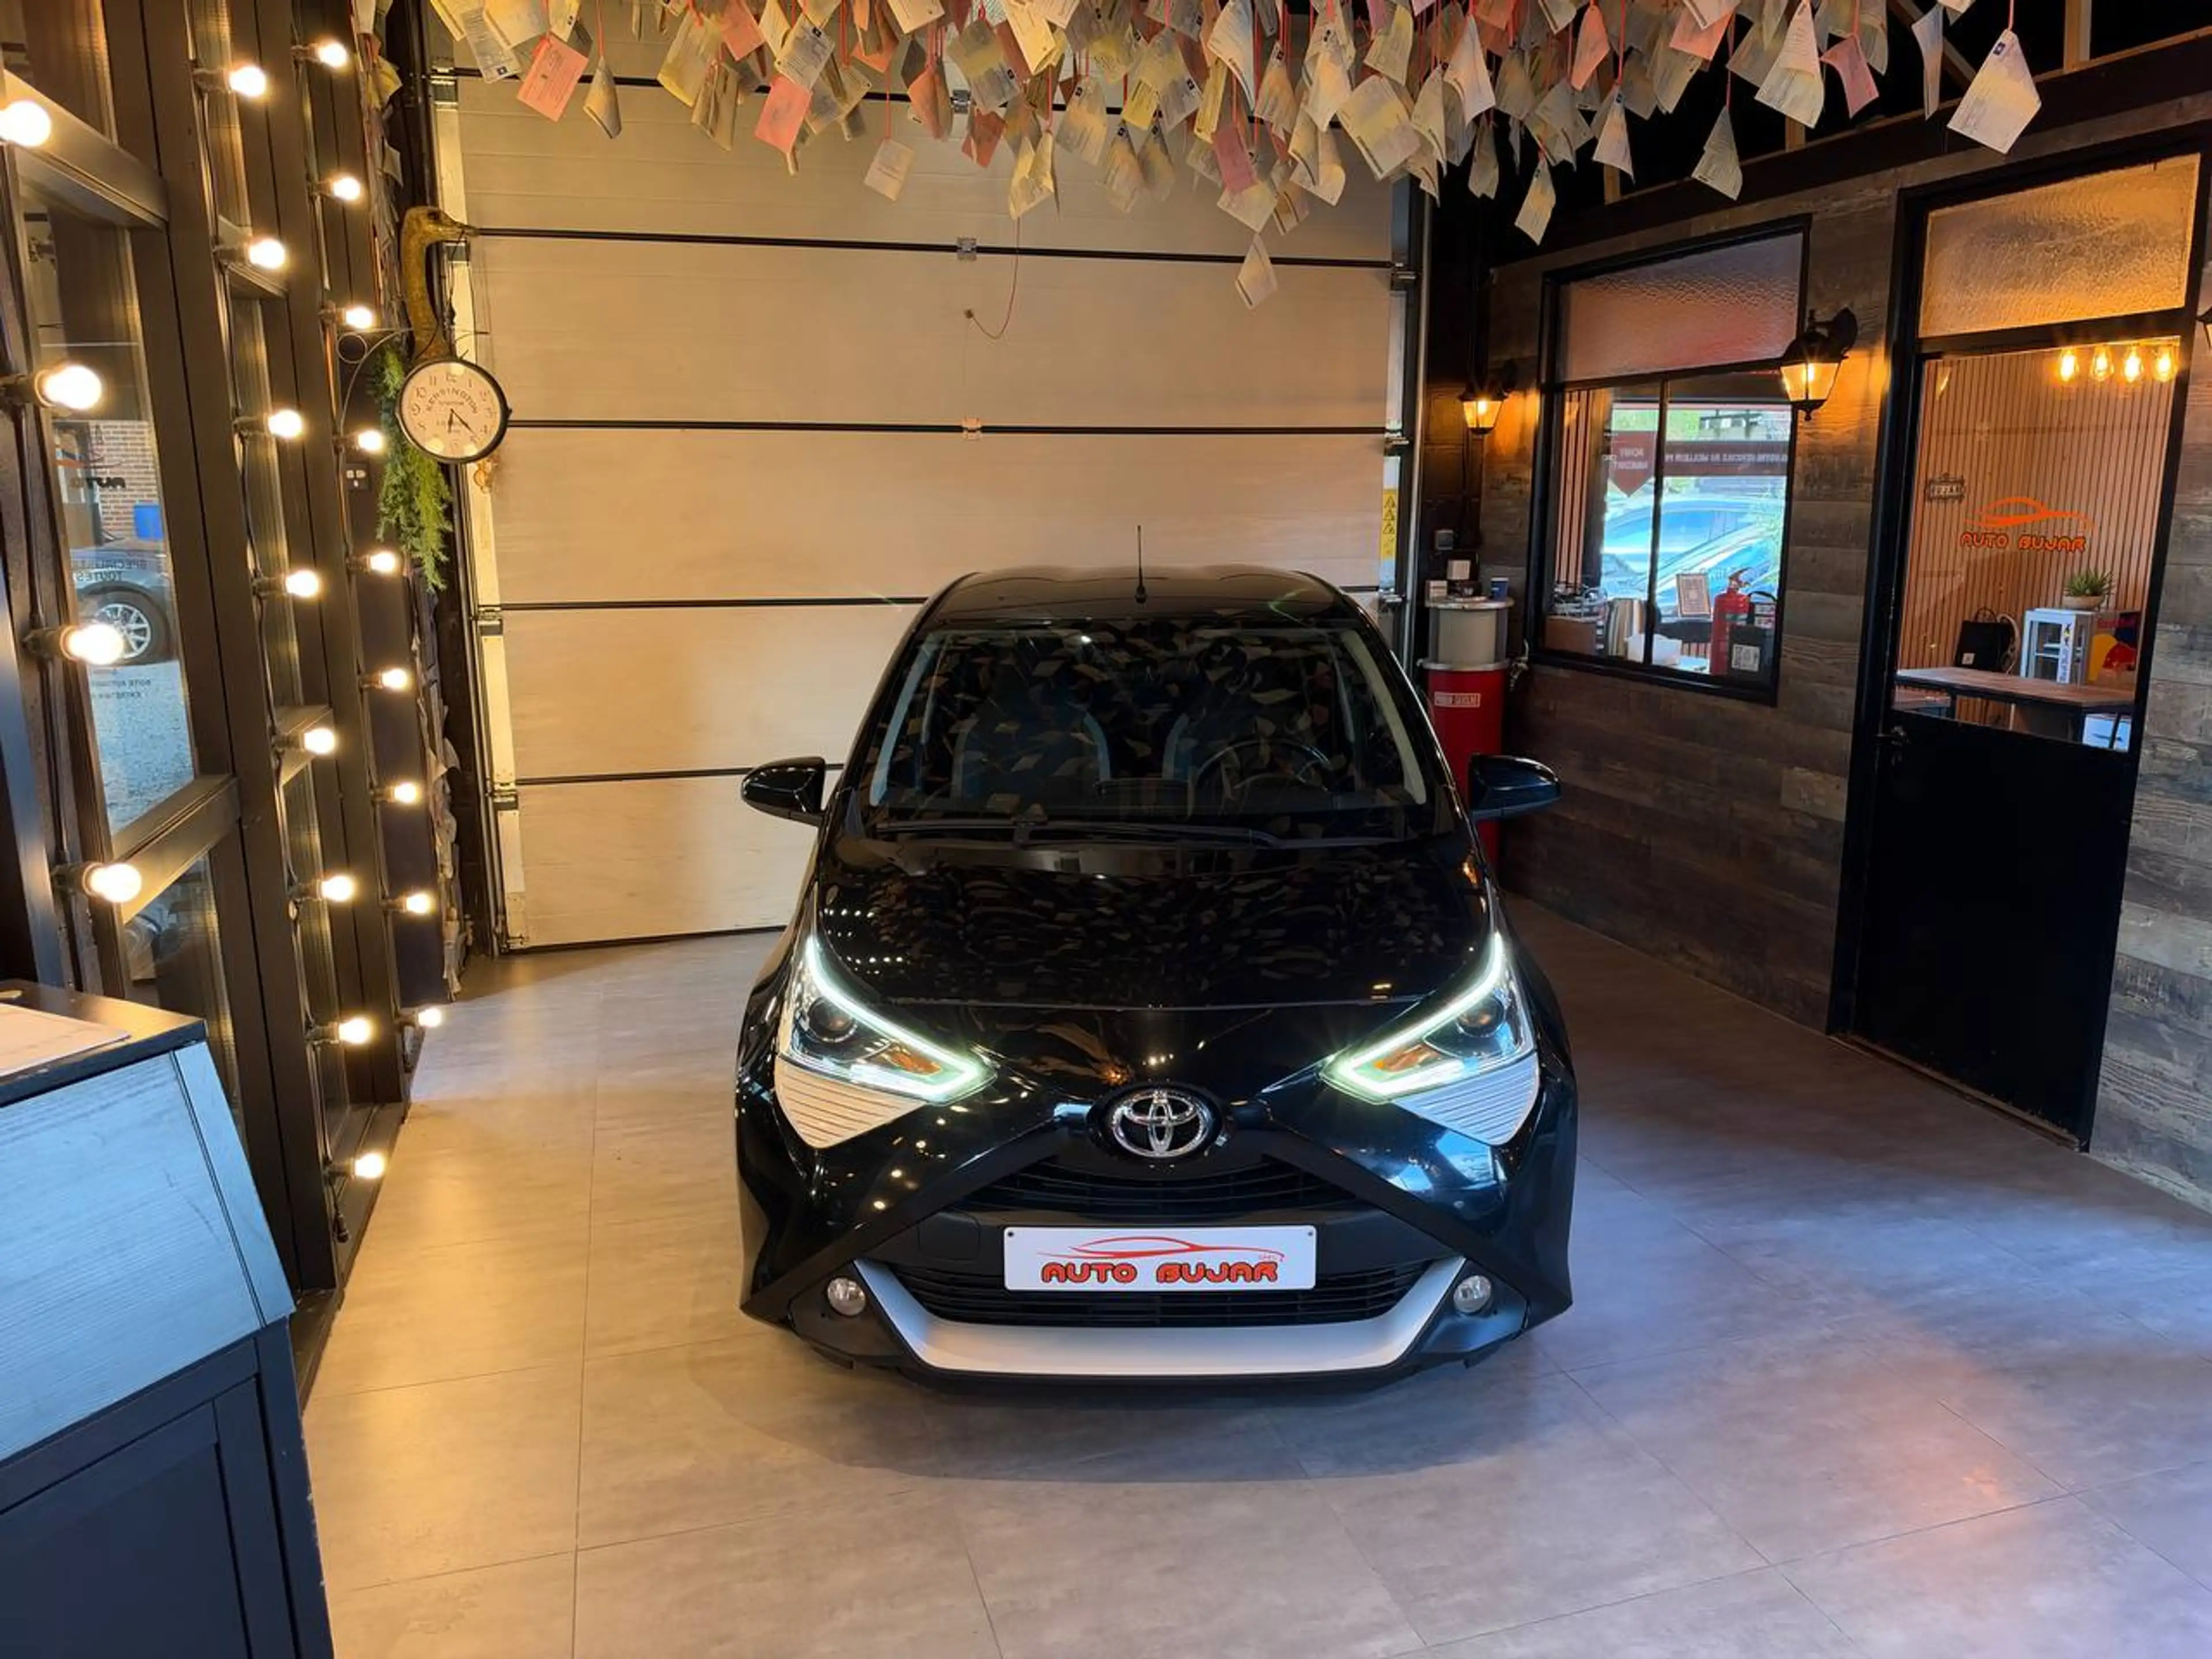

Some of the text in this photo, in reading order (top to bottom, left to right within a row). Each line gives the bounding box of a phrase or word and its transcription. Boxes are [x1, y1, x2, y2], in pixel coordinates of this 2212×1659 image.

[1960, 532, 2086, 552] AUTO BUJAR
[1041, 1262, 1278, 1283] AUTO BUJAR
